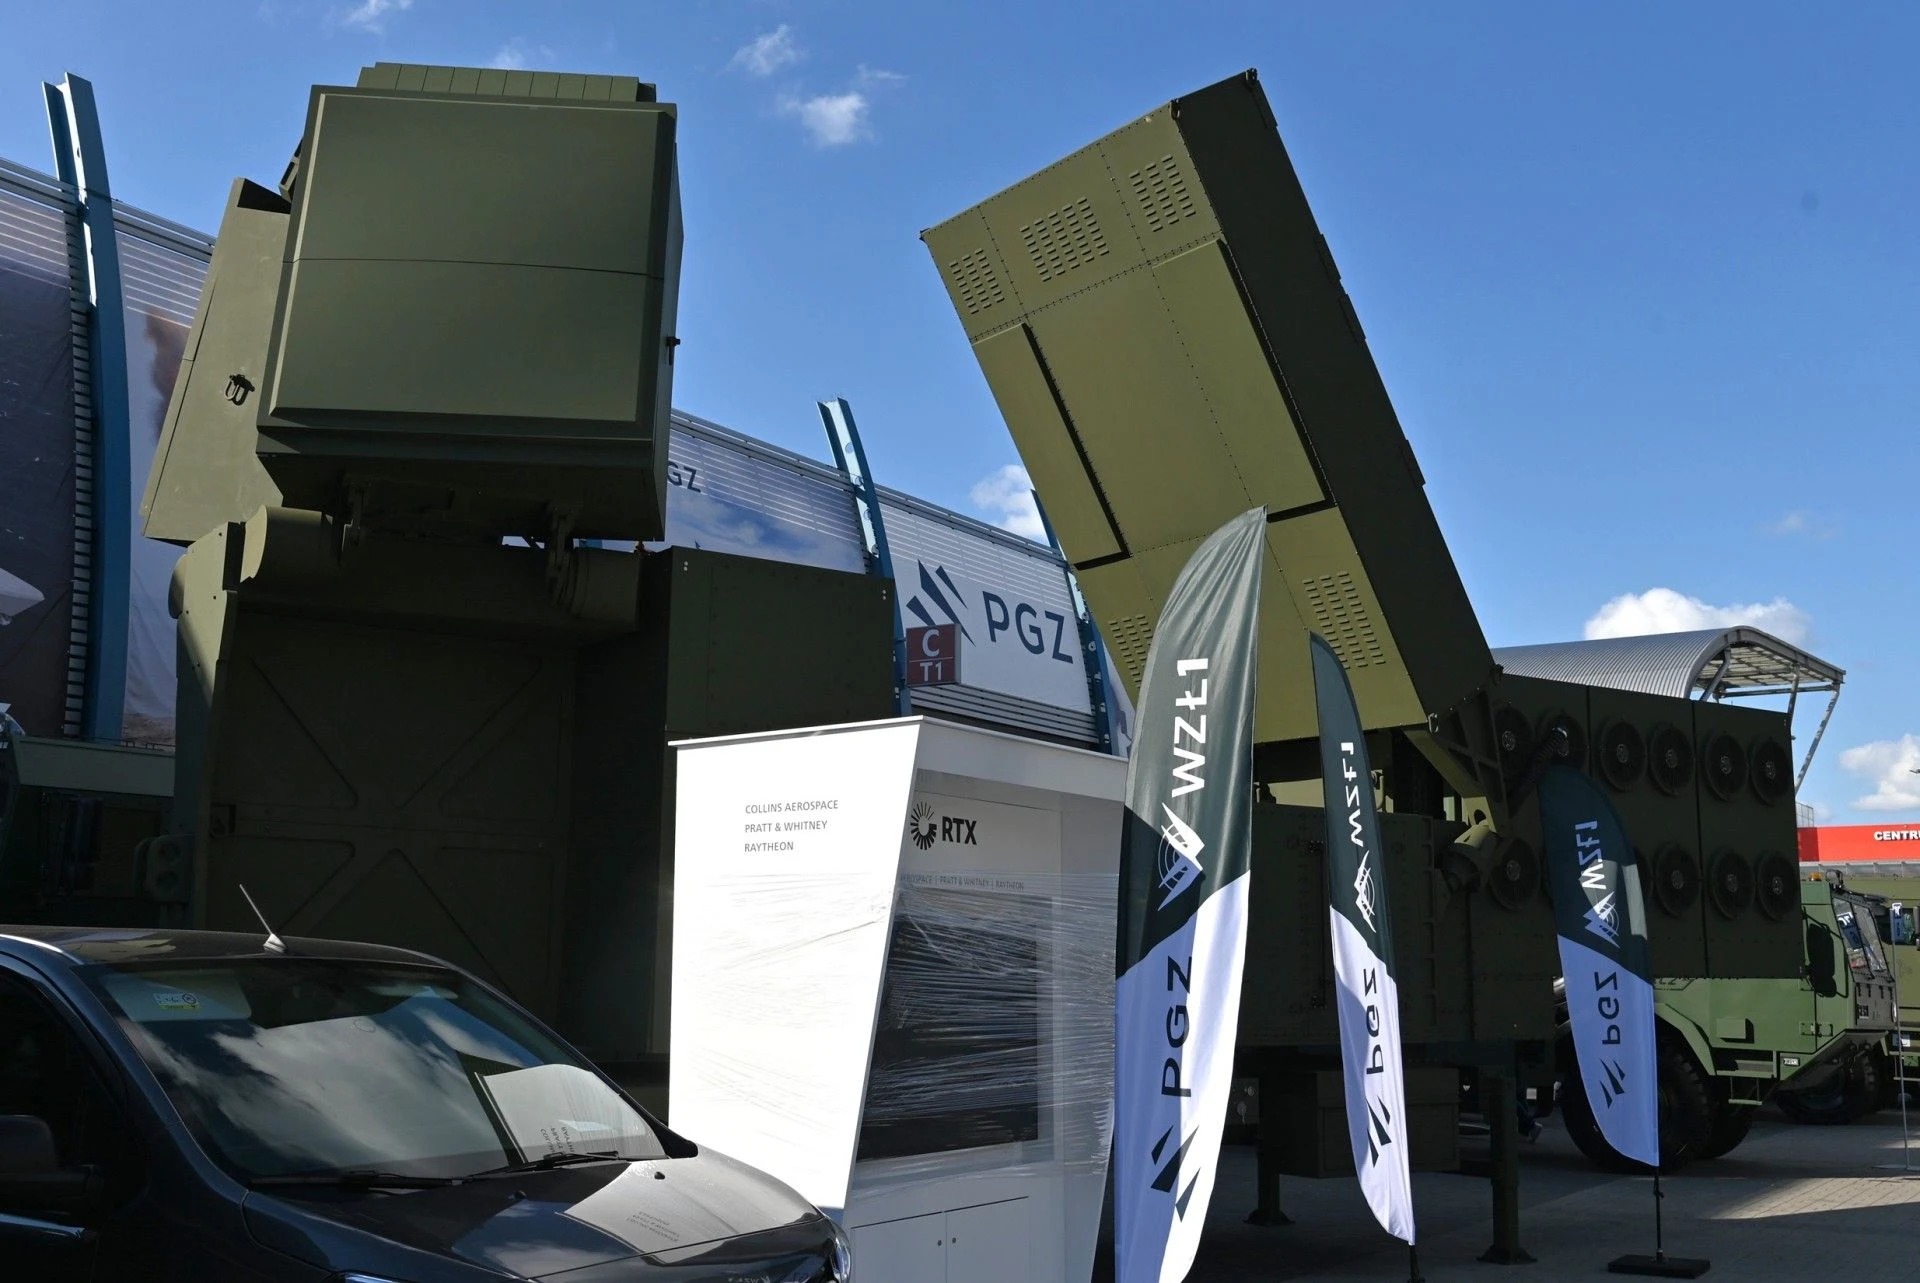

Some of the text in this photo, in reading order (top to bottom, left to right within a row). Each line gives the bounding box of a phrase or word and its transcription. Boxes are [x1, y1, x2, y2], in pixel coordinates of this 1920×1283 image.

[667, 460, 701, 493] GZ
[982, 591, 1073, 664] PGZ
[922, 629, 940, 657] C
[920, 661, 942, 682] T1
[745, 799, 838, 814] COLLINS AEROSPACE
[745, 820, 827, 833] PRATT & WHITNEY
[942, 815, 977, 845] RTX
[1873, 830, 1920, 841] CENTR
[744, 841, 794, 852] RAYTHEON
[1161, 955, 1192, 1097] PGZ
